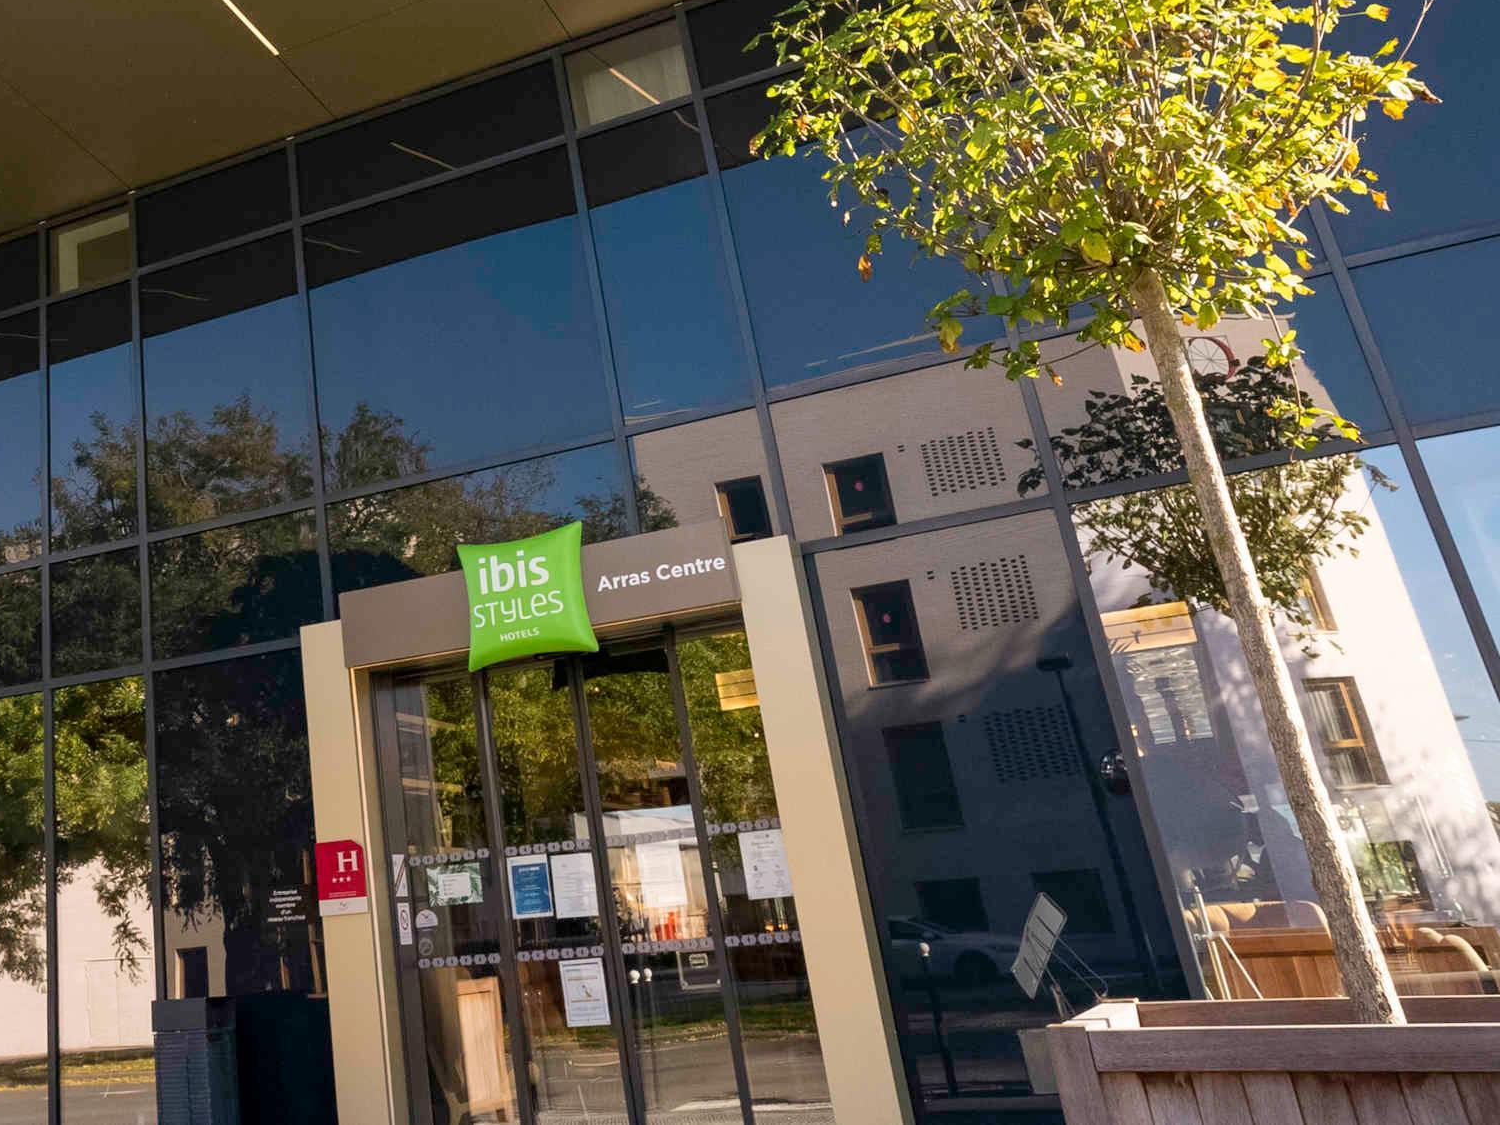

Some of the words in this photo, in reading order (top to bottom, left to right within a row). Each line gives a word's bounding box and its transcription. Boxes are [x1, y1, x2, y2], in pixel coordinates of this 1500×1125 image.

[478, 550, 550, 595] ibis
[598, 571, 650, 592] Arras
[656, 557, 725, 581] Centre
[500, 627, 540, 642] HOTELS
[337, 850, 358, 873] H
